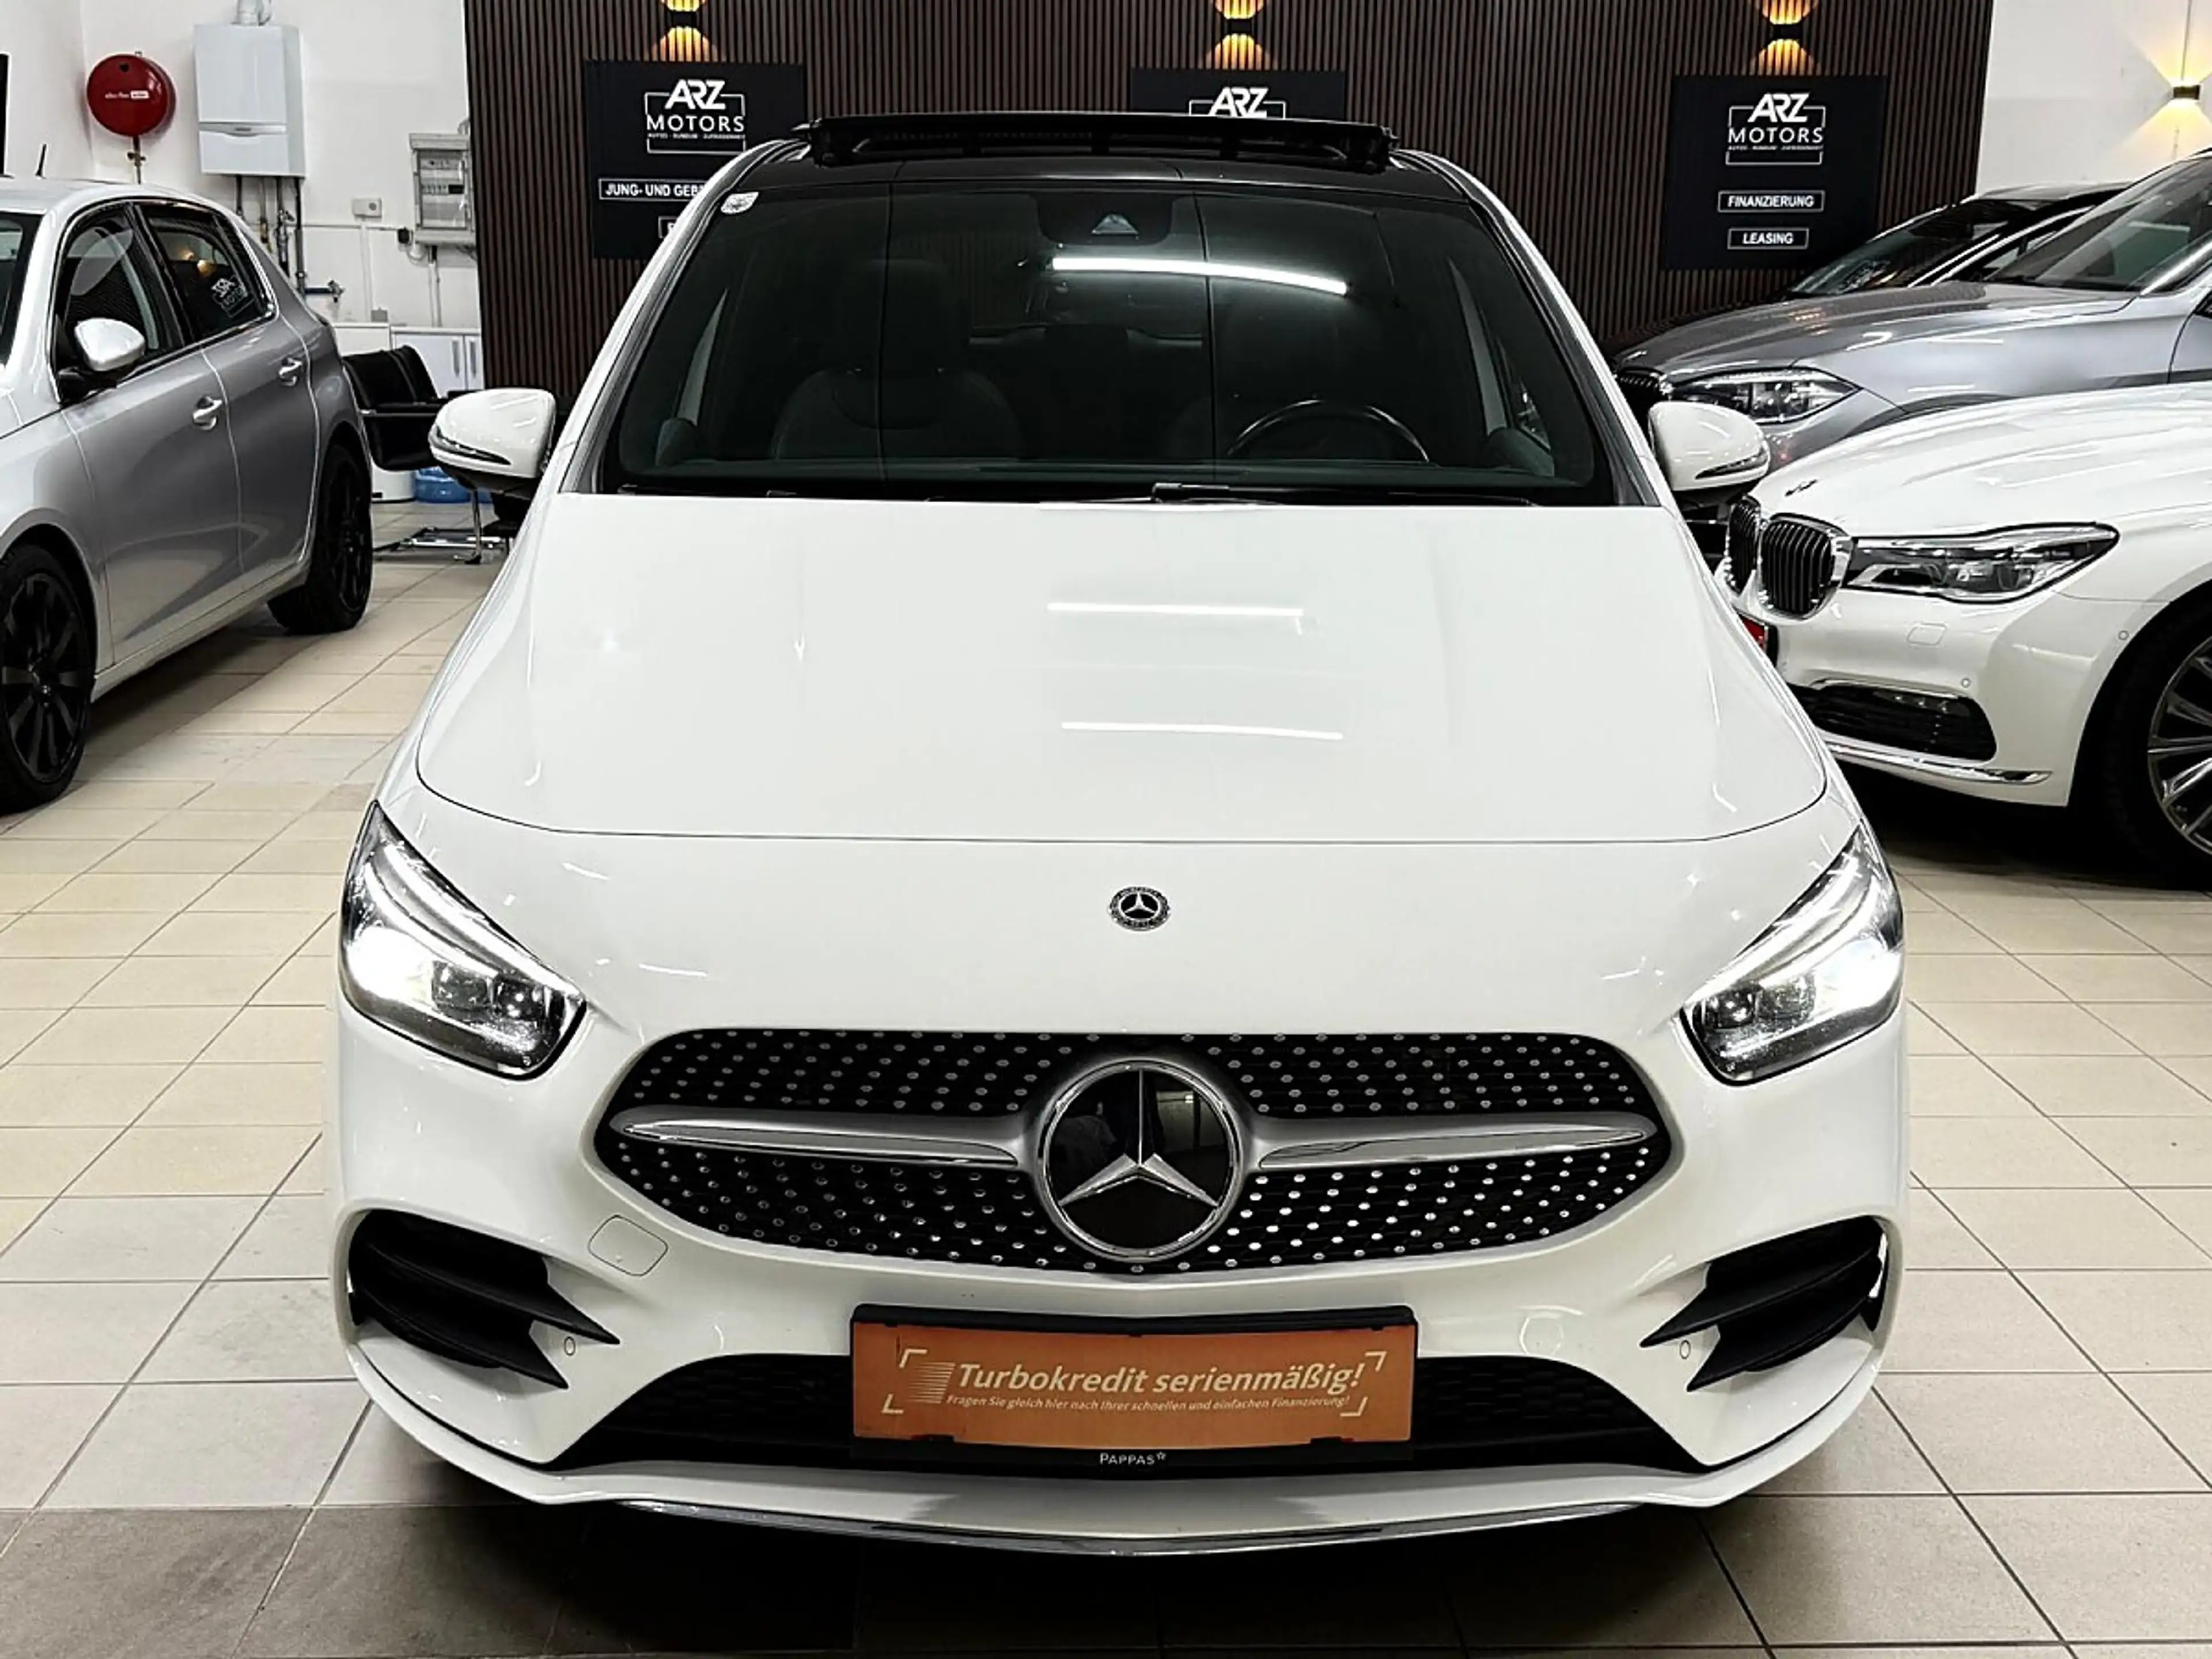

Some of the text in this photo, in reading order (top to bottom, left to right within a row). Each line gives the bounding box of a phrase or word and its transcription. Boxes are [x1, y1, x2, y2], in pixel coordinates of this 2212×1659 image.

[665, 79, 726, 109] ARZ
[1208, 86, 1268, 118] ARZ
[1747, 92, 1810, 123] ARZ
[646, 115, 745, 132] MOTORS
[1728, 127, 1824, 143] MOTORS
[605, 183, 643, 196] JUNG-
[645, 184, 671, 196] UND
[1728, 195, 1815, 207] FINANZIERUNG
[1742, 232, 1794, 245] LEASING
[959, 1362, 1365, 1395] Turbokredit serienmäßig!
[946, 1394, 987, 1408] Fragen
[988, 1395, 1006, 1407] Sie
[1007, 1397, 1043, 1410] gleich
[1045, 1398, 1069, 1408] hier
[1070, 1400, 1099, 1410] nach
[1131, 1400, 1187, 1411] schnellen
[1188, 1399, 1212, 1410] und
[1213, 1398, 1270, 1410] einfachen
[1271, 1395, 1351, 1408] Finanzierung!
[1099, 1452, 1155, 1465] PAPPAS
